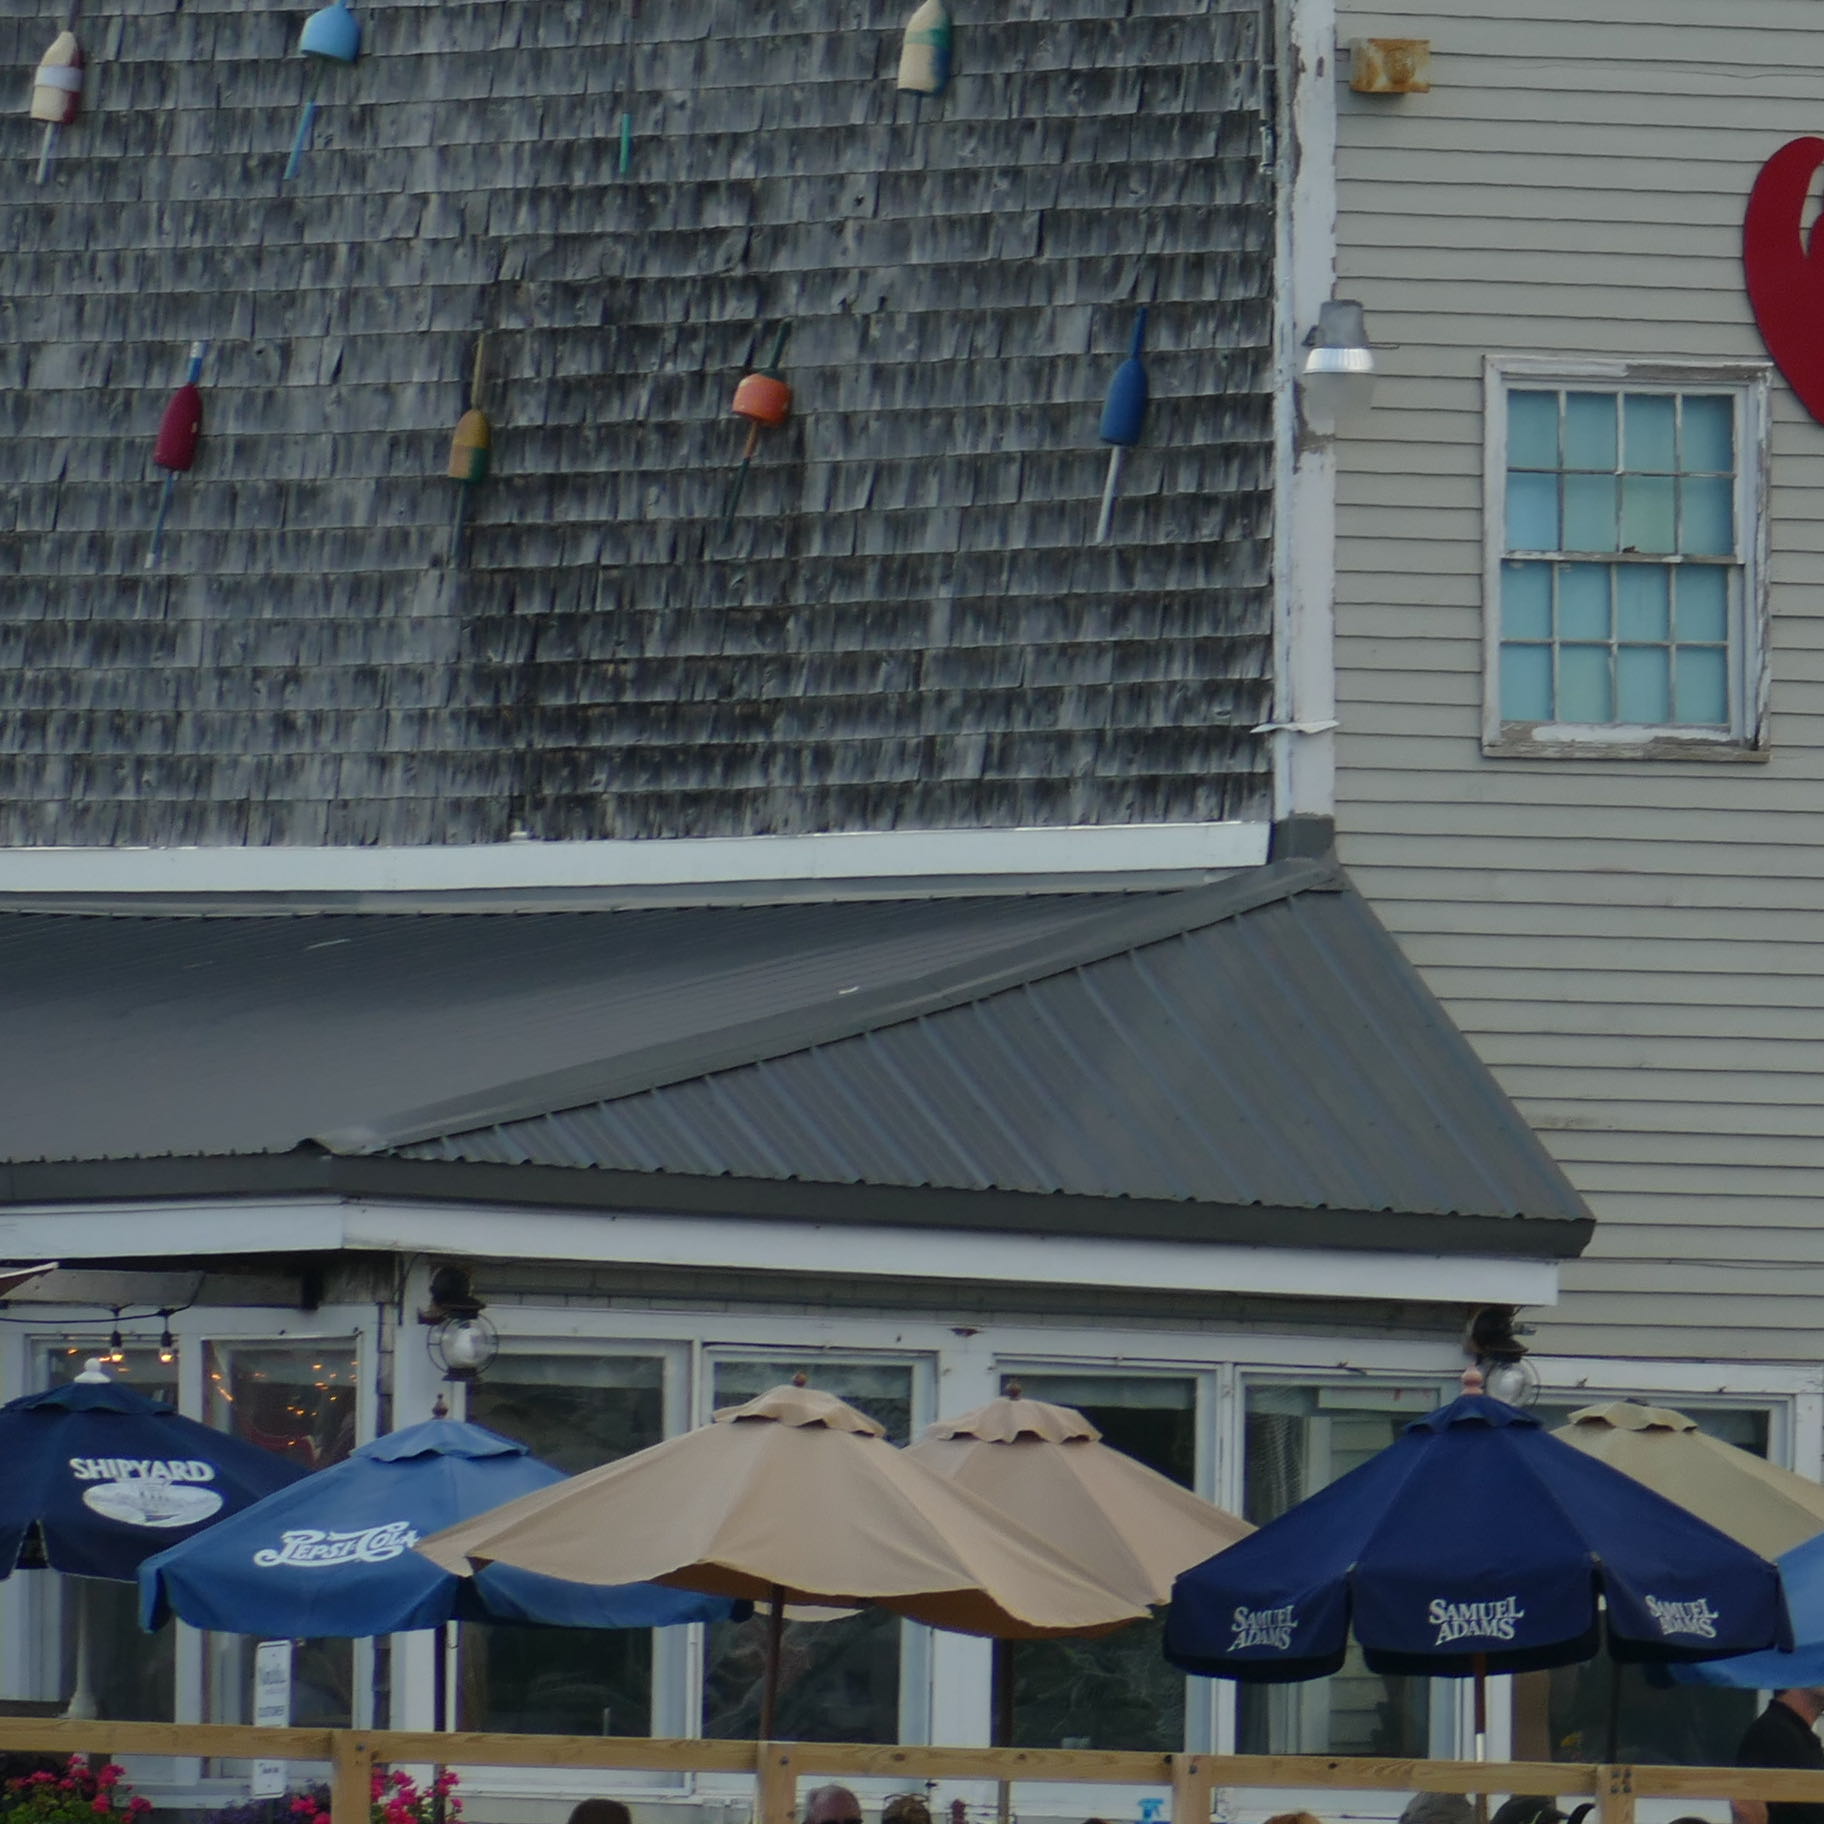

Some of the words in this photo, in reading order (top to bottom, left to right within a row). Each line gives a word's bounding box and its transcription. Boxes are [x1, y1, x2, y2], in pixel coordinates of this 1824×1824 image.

[69, 1457, 216, 1482] SHIPYARD
[1231, 1604, 1298, 1632] SAMUEL
[1428, 1595, 1525, 1624] SAMUEL
[1645, 1594, 1719, 1620] SAMUEL
[1435, 1619, 1517, 1647] ADAMS
[1659, 1614, 1717, 1638] ADAMS
[1226, 1627, 1292, 1652] ADAMS
